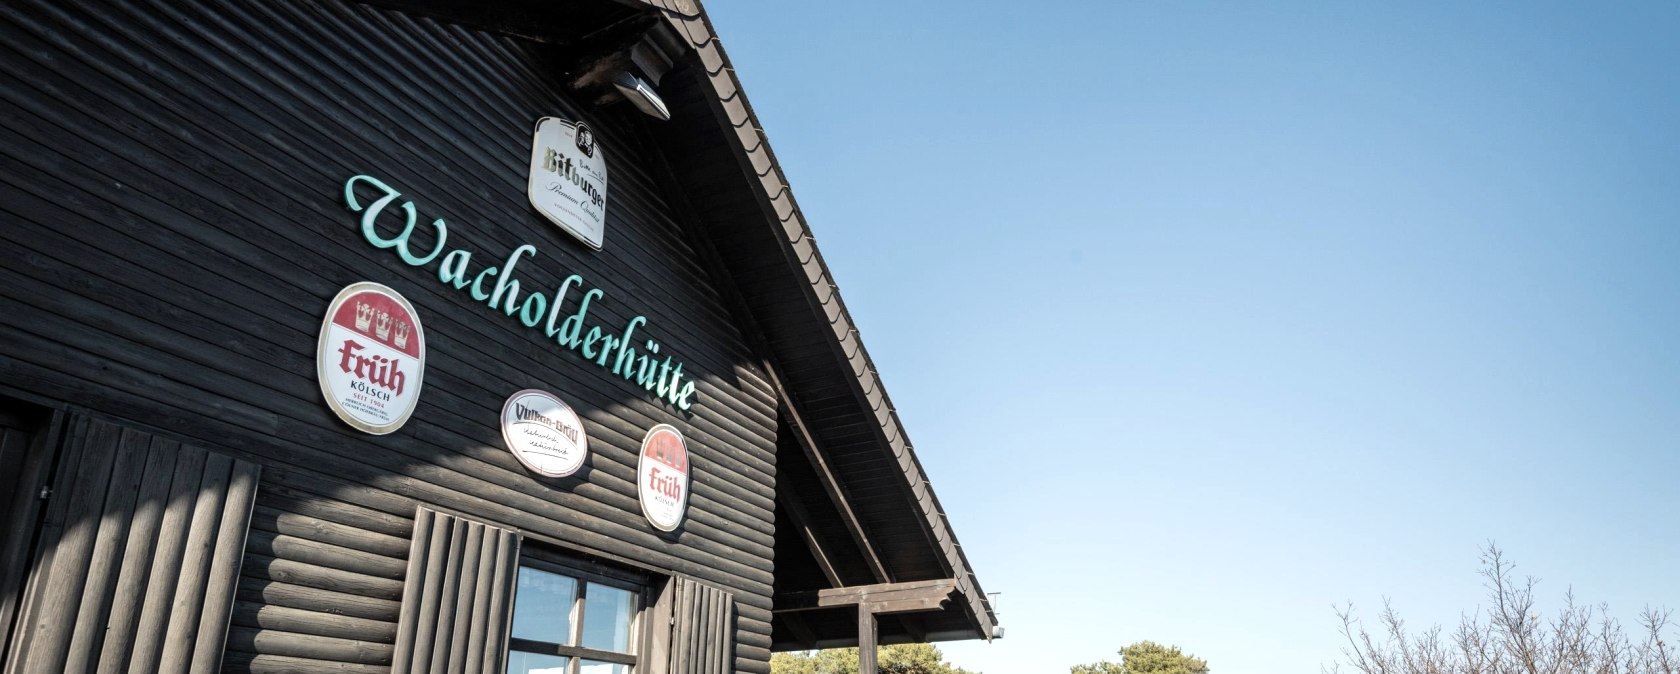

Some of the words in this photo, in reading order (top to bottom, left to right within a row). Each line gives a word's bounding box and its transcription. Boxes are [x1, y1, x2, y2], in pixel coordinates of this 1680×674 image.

[543, 146, 605, 211] Bitburger
[545, 181, 579, 205] Premium
[343, 174, 695, 410] Wacholderhütte
[338, 339, 406, 397] Früh
[350, 380, 390, 402] KÖLSCH
[353, 392, 367, 402] SEIT
[370, 399, 385, 409] 1904
[648, 466, 681, 504] Früh
